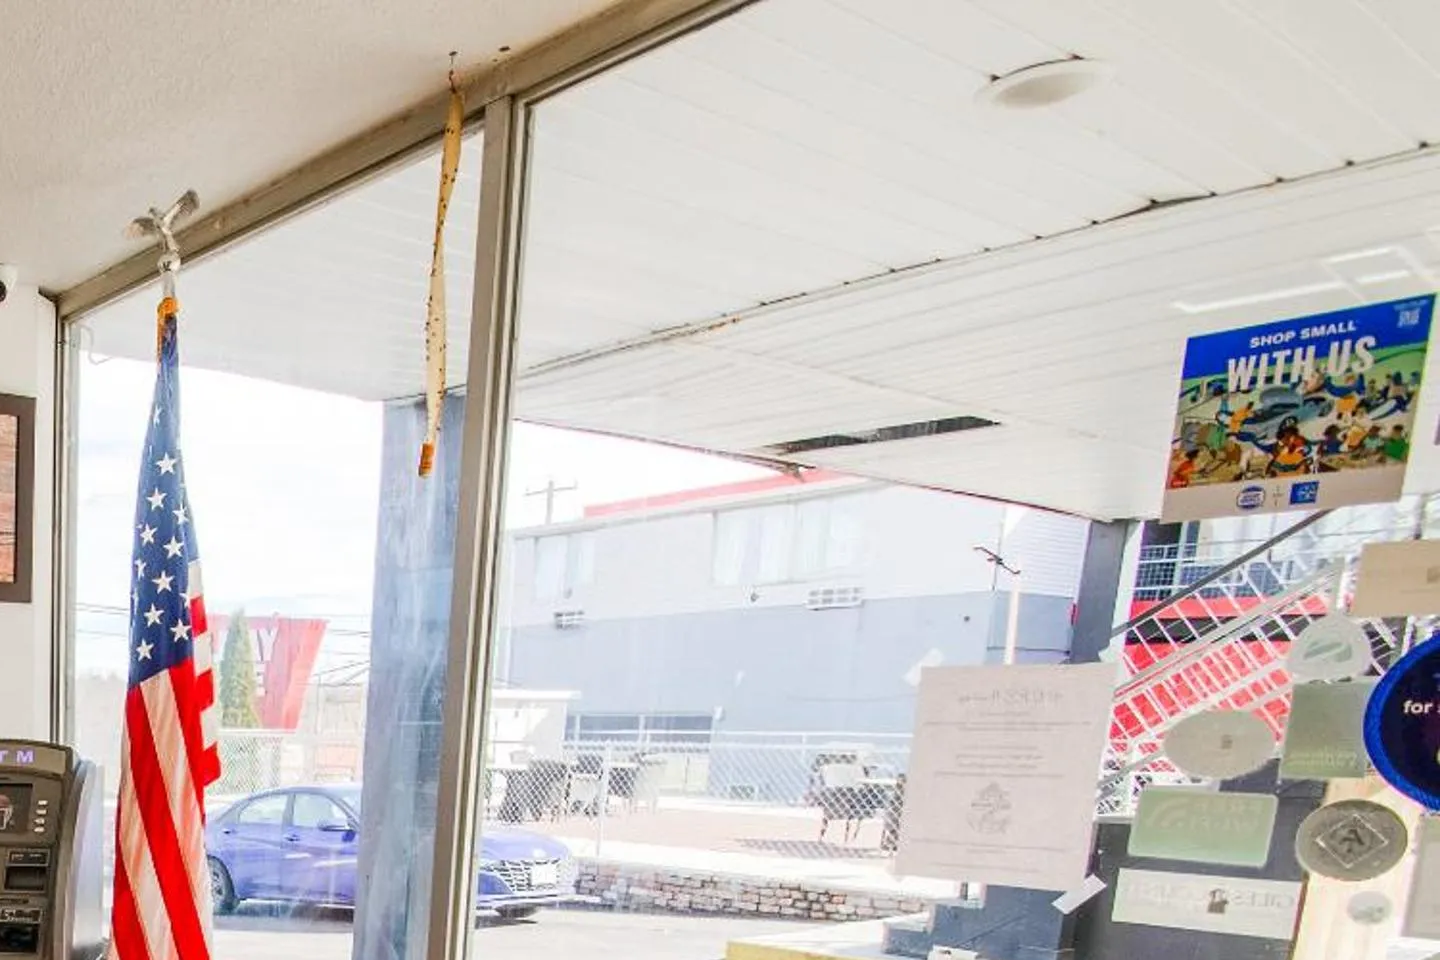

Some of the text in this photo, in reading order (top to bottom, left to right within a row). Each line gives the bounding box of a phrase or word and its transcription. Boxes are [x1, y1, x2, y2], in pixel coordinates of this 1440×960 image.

[1249, 319, 1357, 349] SHOP SMALL
[1227, 335, 1377, 393] WITH US
[1402, 699, 1434, 717] for
